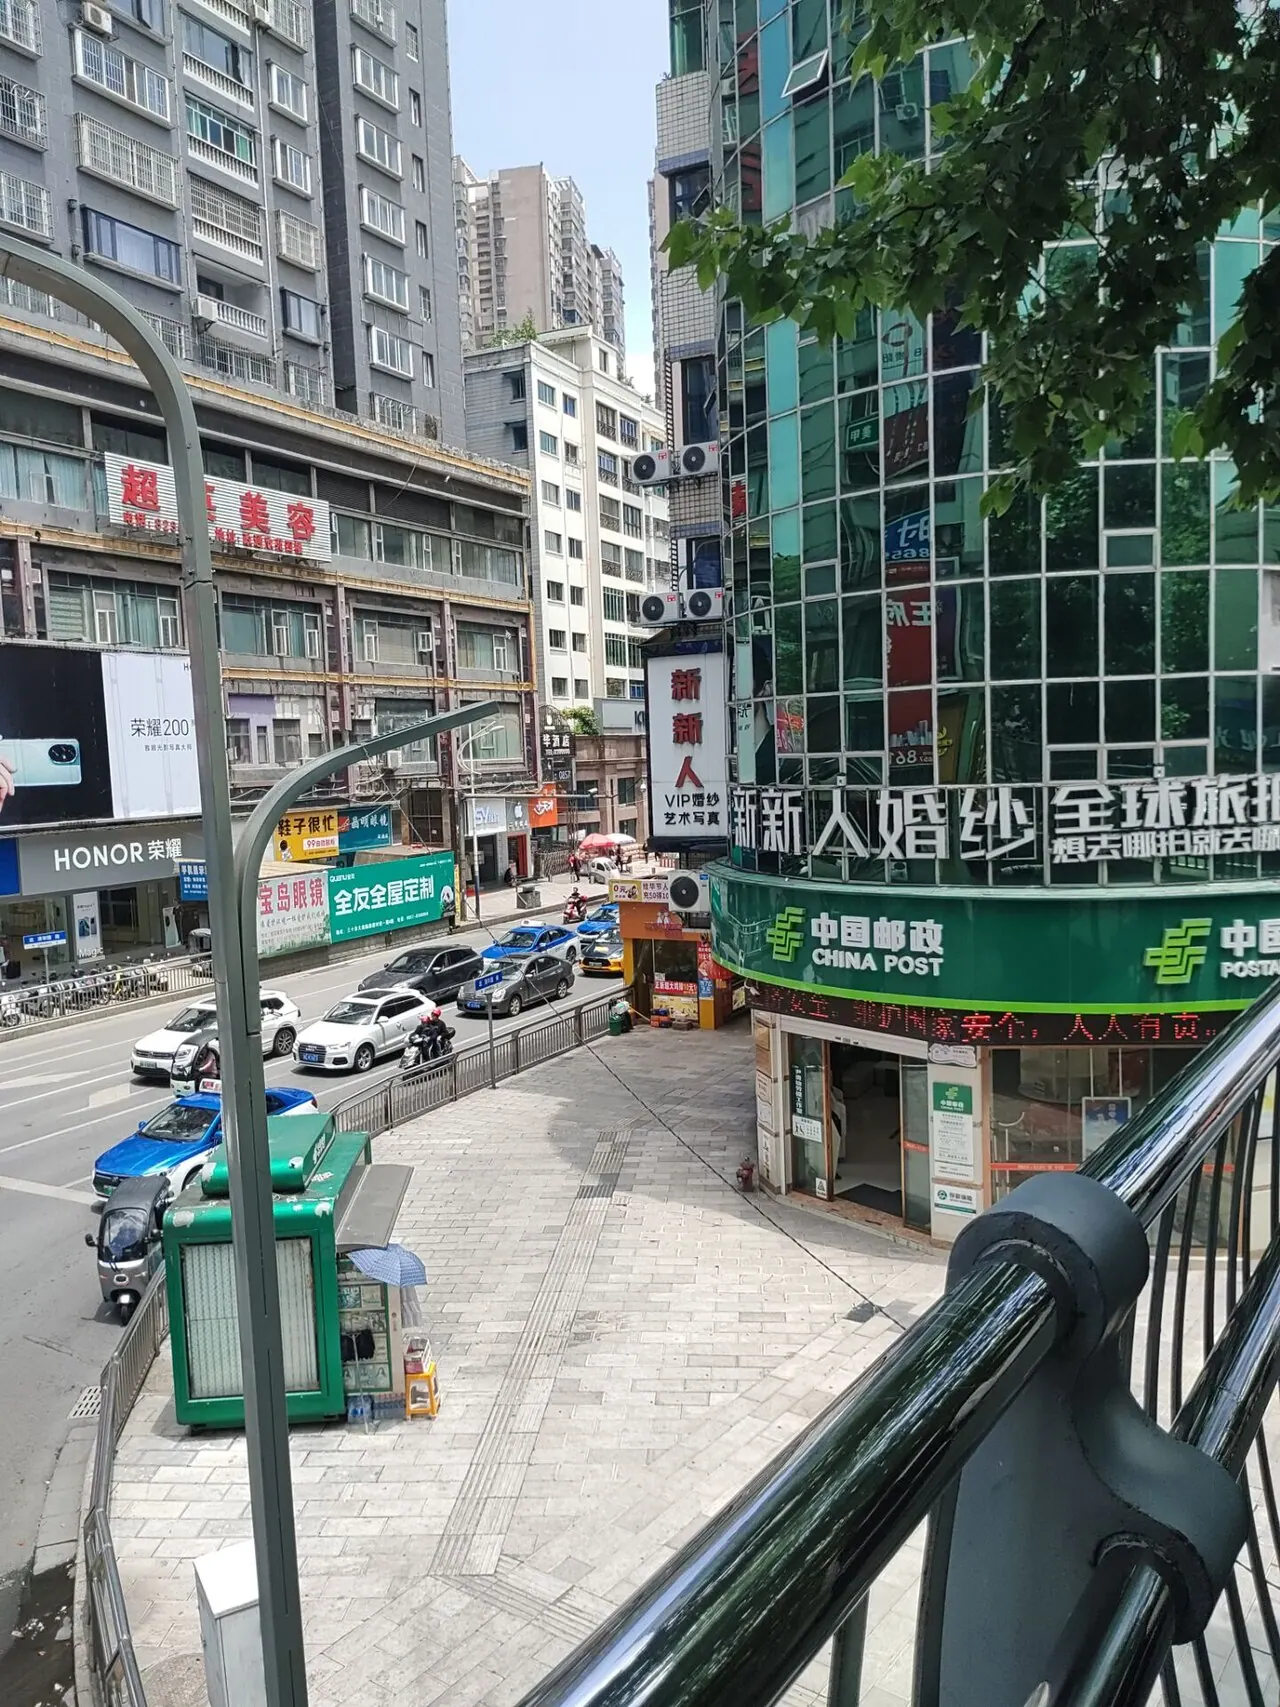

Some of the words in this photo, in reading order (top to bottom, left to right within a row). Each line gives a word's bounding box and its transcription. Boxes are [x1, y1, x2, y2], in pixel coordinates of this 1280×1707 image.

[130, 718, 189, 737] 荣耀200
[671, 667, 704, 788] 新新人
[278, 814, 335, 837] 鞋子很忙
[664, 811, 720, 826] 艺术写真
[733, 786, 1037, 861] 新新人婚纱
[54, 842, 145, 872] HONOR
[147, 837, 183, 860] 荣耀
[258, 877, 324, 916] 宝岛眼镜
[333, 874, 435, 917] 全友全屋定制
[810, 912, 944, 955] 中国邮政
[811, 948, 878, 971] CHINA
[884, 954, 944, 976] POST
